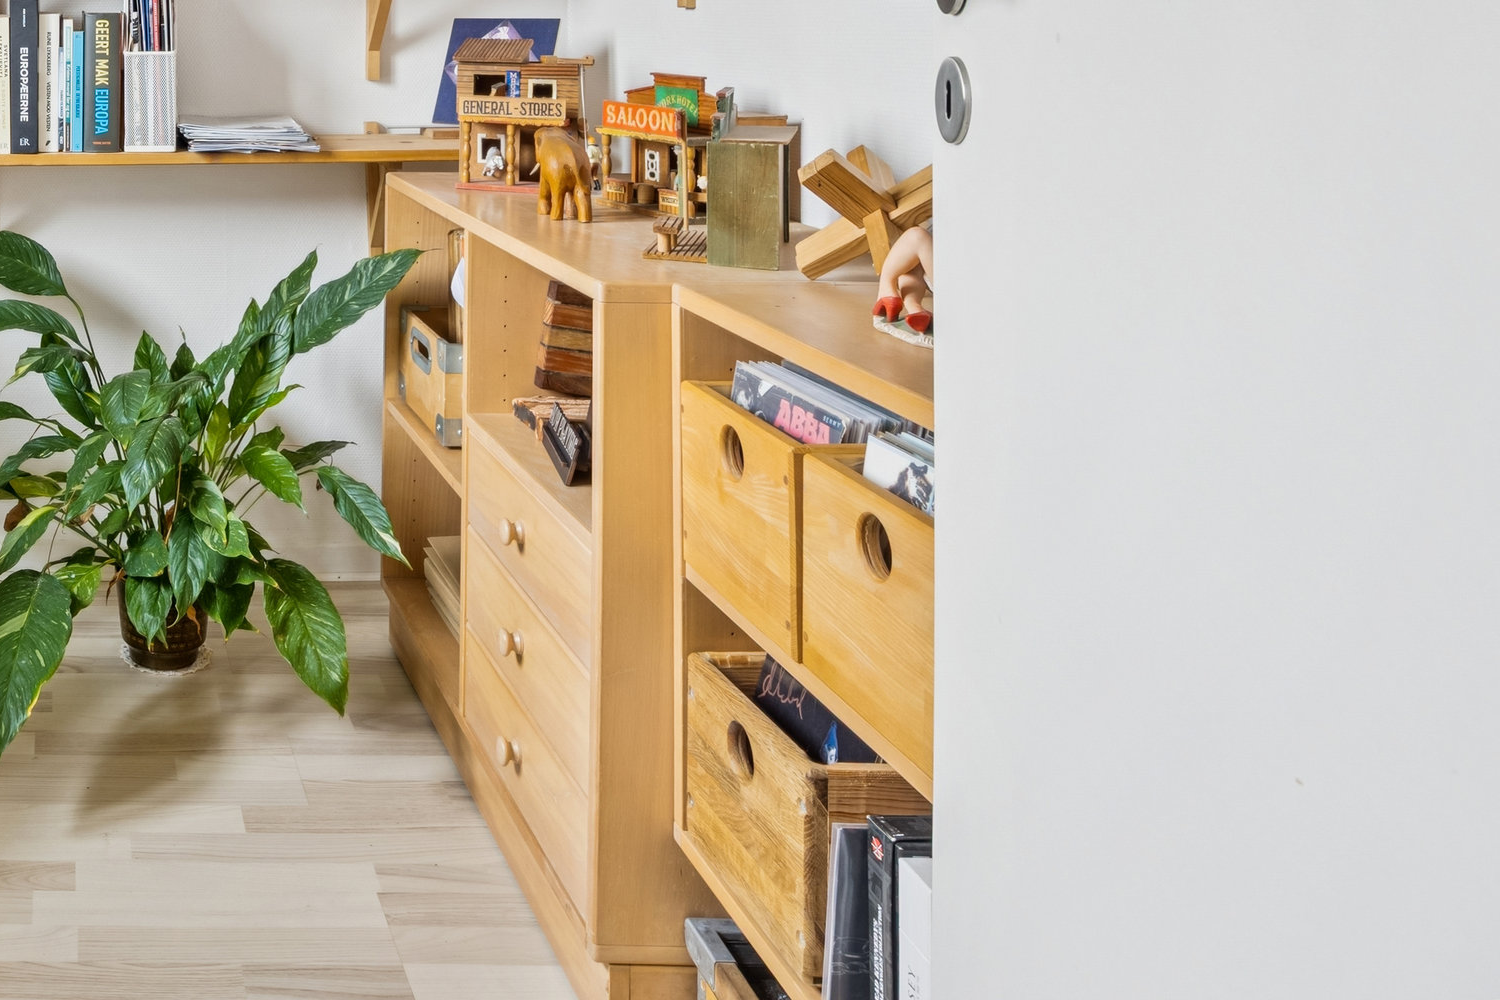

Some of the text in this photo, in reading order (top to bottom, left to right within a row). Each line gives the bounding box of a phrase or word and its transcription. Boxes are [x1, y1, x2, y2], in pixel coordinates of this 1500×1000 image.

[95, 20, 109, 85] GEERT MAK
[20, 47, 29, 121] EUROPÆERNE
[95, 89, 109, 134] EUROPA
[606, 104, 674, 132] SALOON
[774, 398, 830, 444] ABBA
